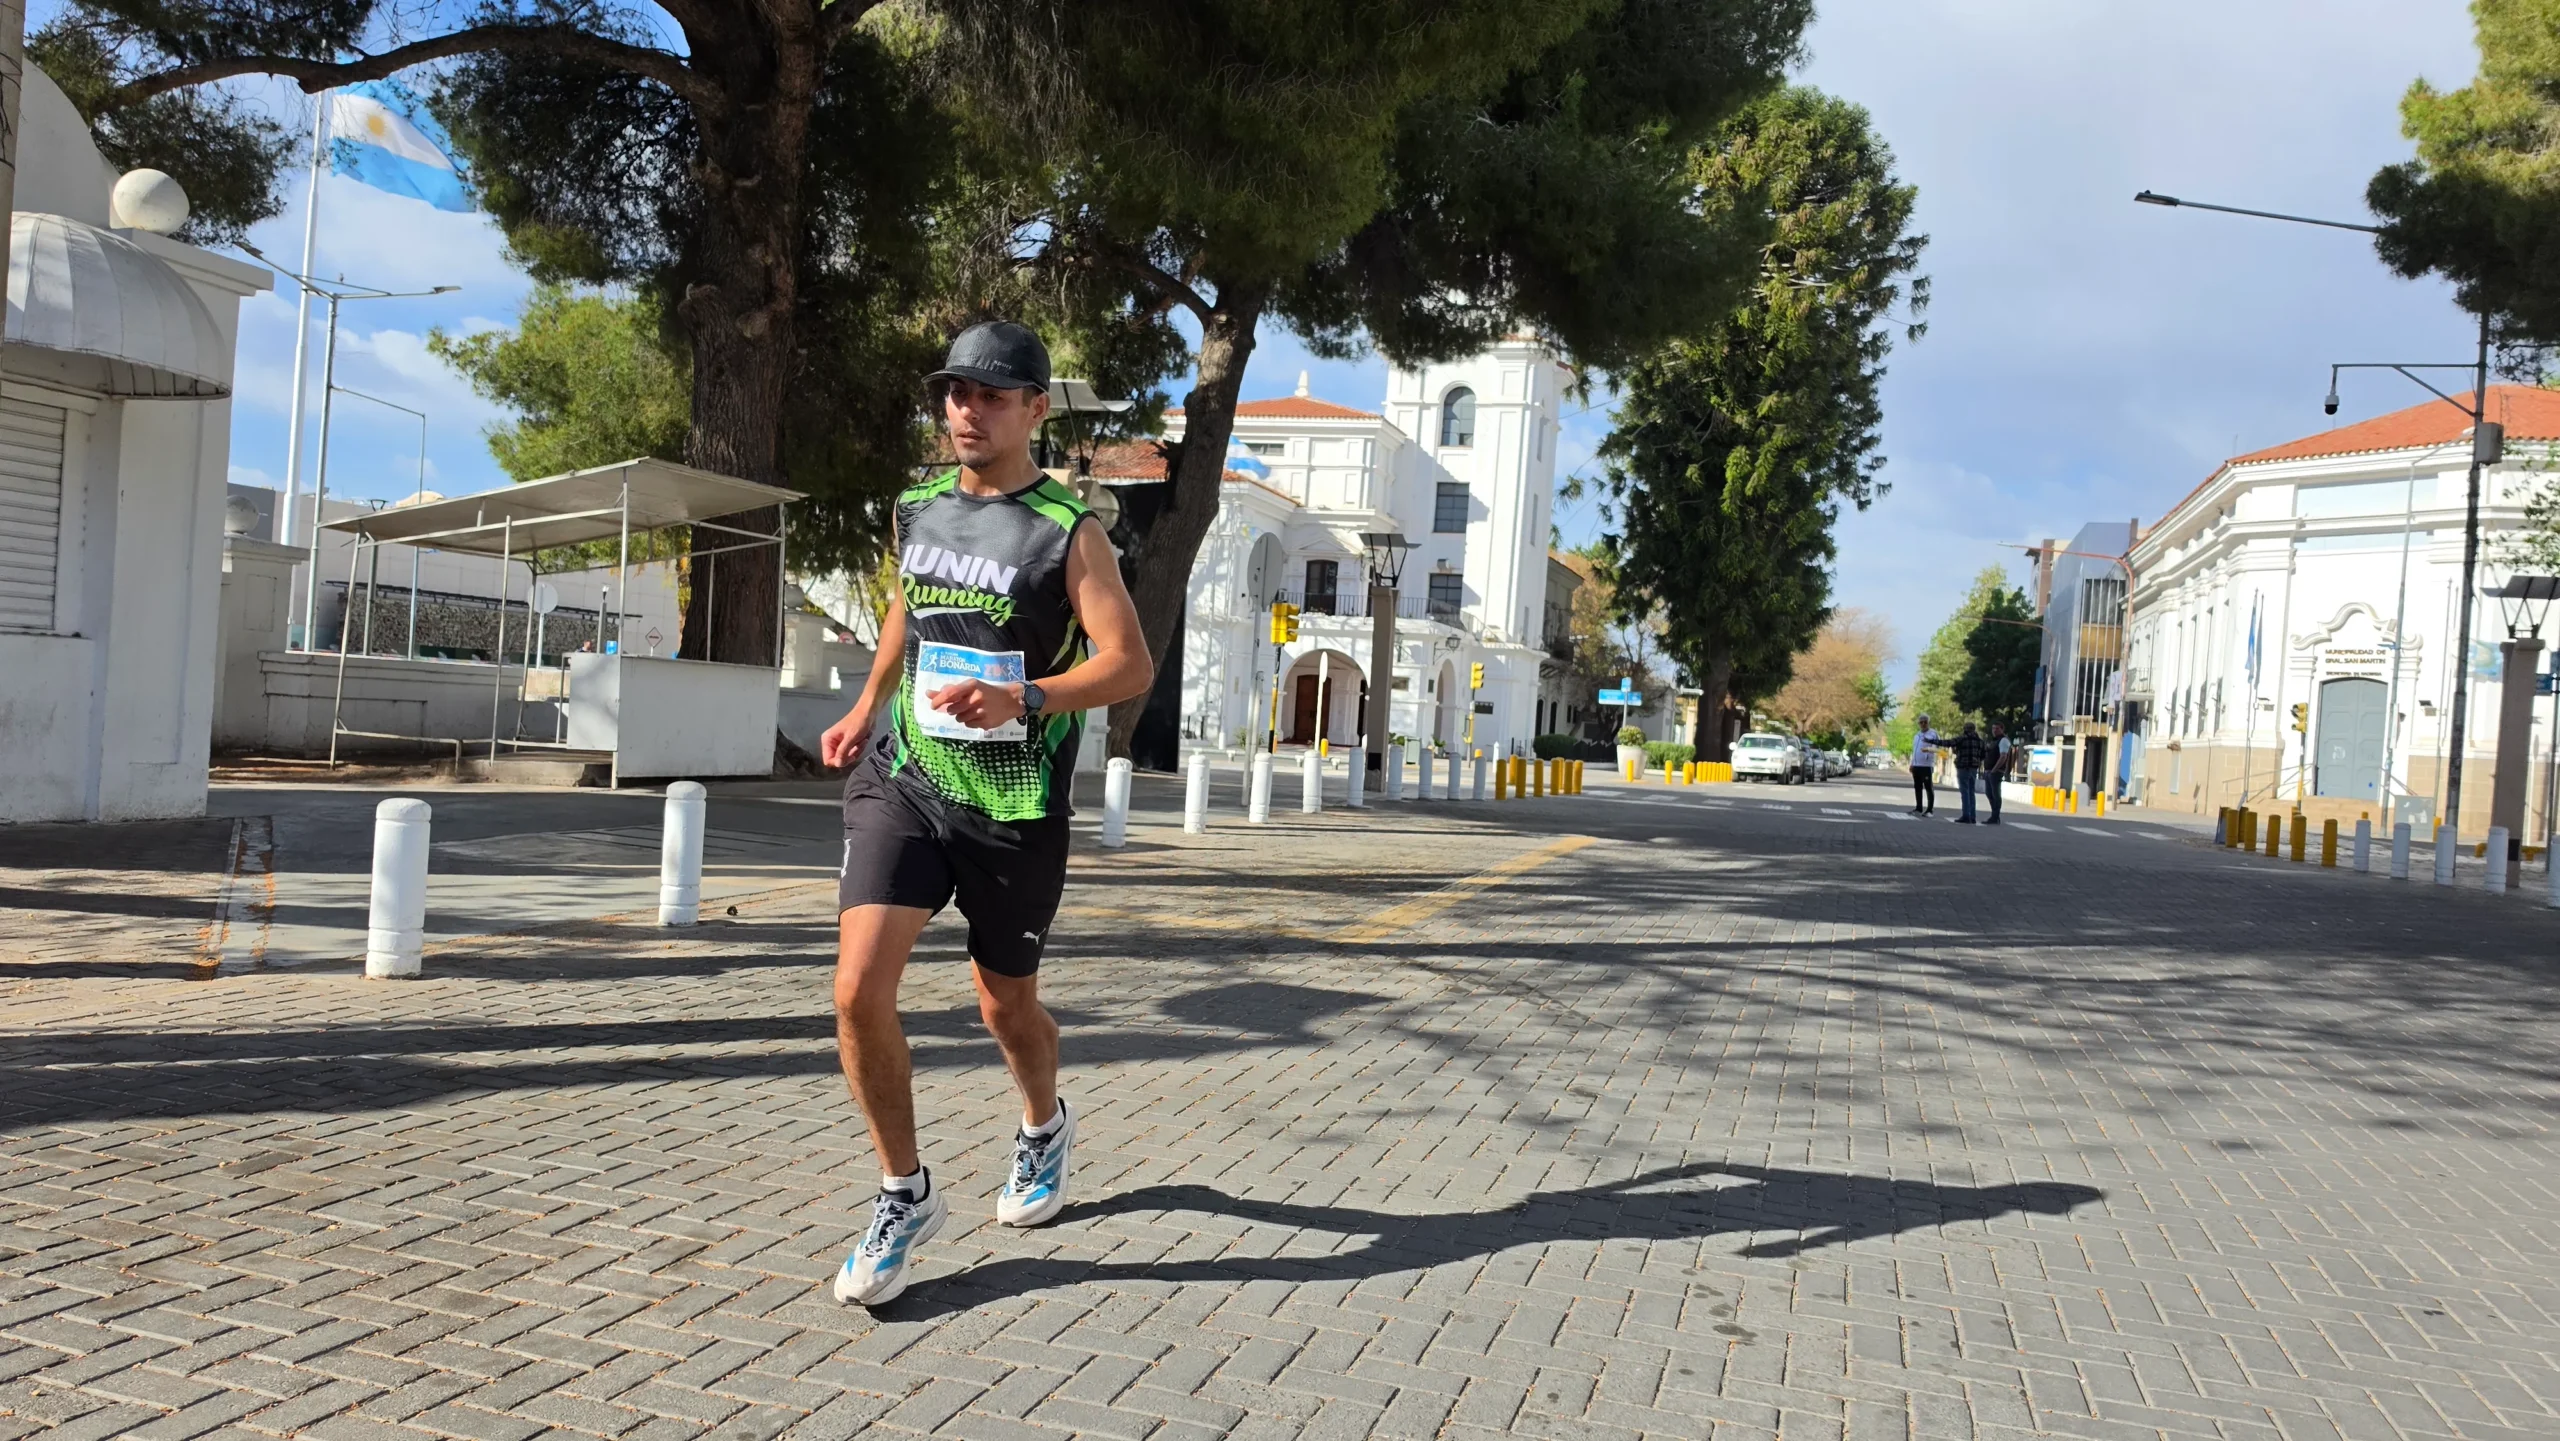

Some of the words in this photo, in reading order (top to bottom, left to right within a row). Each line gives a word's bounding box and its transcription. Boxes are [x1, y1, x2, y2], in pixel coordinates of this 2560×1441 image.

[900, 544, 1018, 595] JUNIN
[900, 572, 1017, 627] Running
[940, 659, 981, 673] BONARDA
